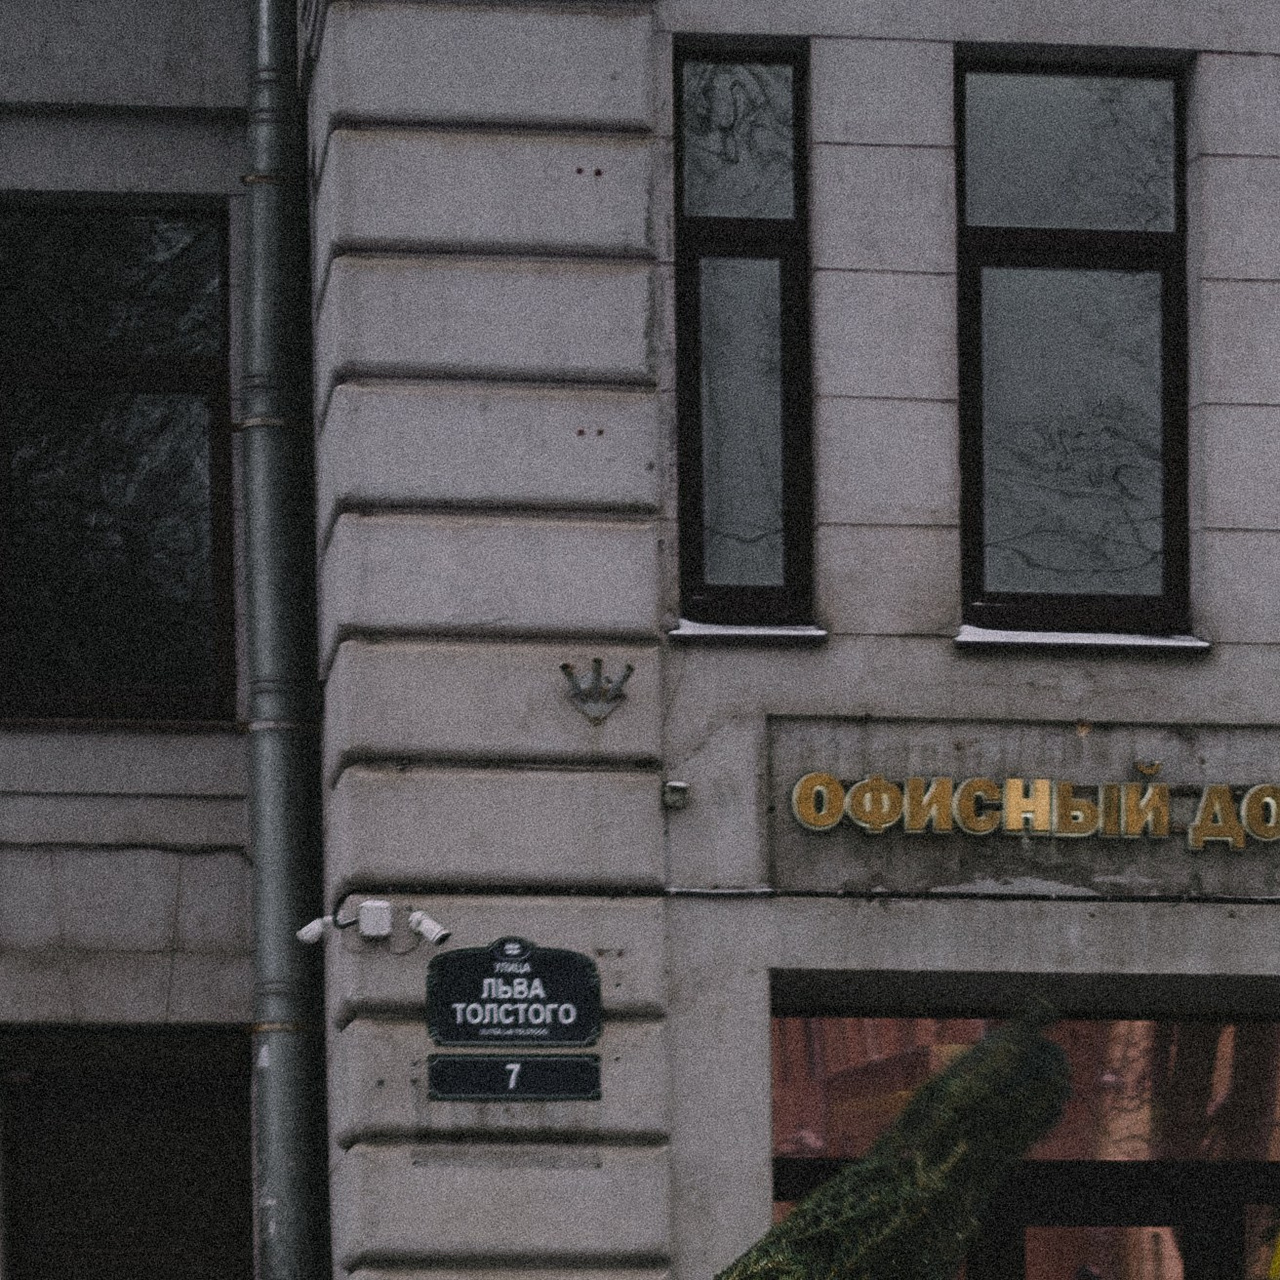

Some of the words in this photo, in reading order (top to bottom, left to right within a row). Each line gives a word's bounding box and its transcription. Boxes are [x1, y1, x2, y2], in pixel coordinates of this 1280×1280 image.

[792, 761, 1171, 838] ОФИСНЫЙ
[494, 961, 531, 975] УЛИЦА
[481, 977, 546, 999] ЛЬВА
[451, 1002, 577, 1025] ТОЛСТОГО
[505, 1063, 521, 1090] 7
